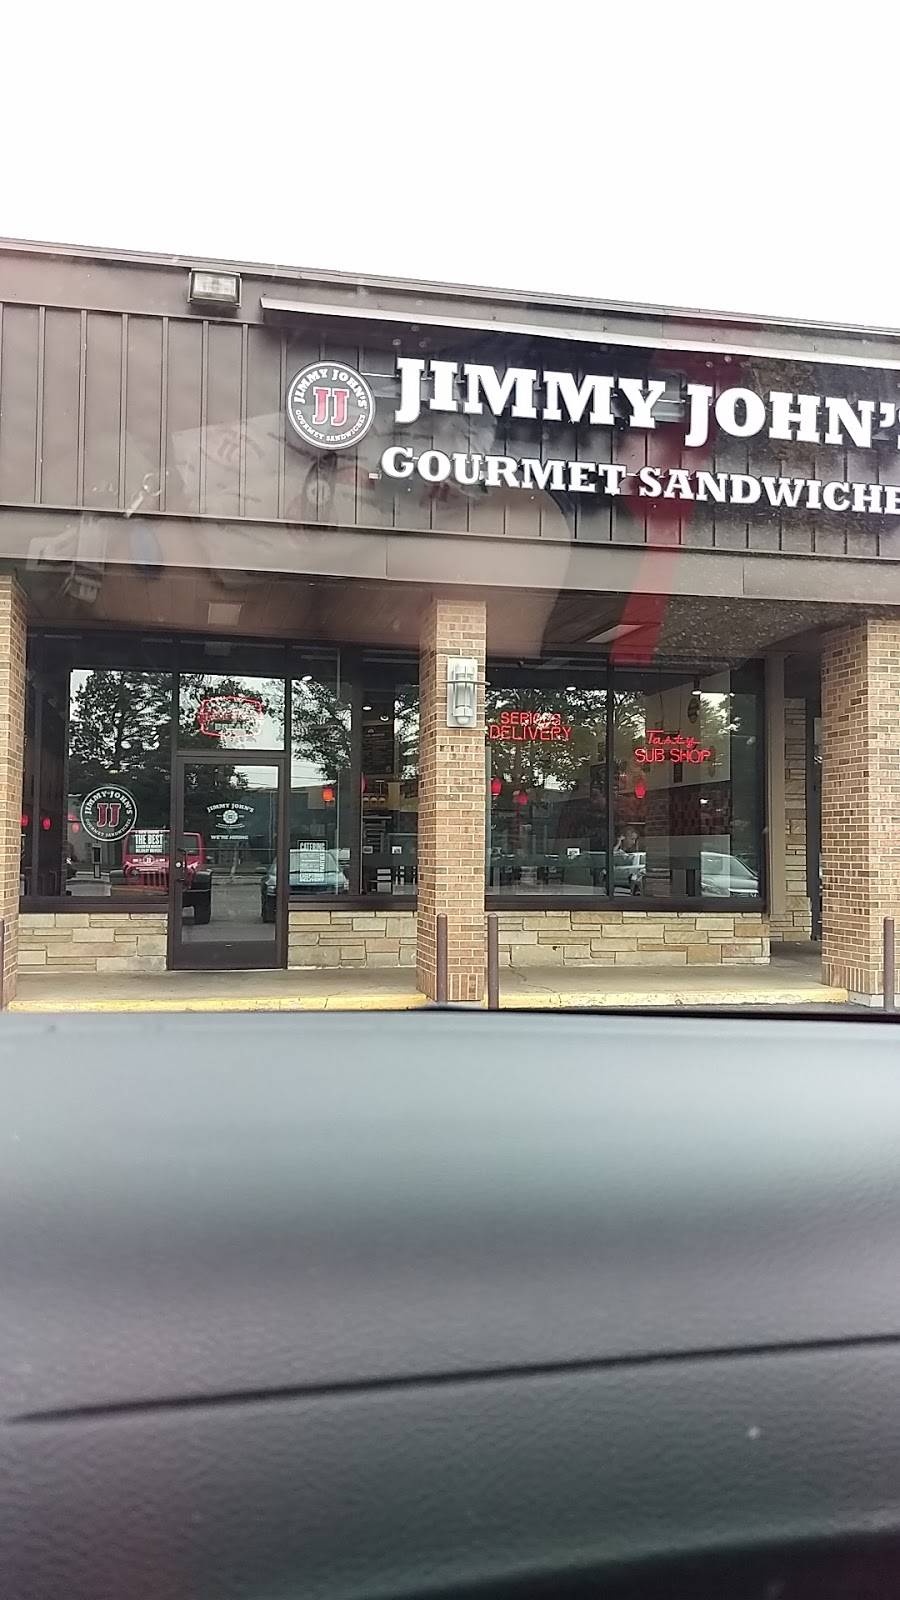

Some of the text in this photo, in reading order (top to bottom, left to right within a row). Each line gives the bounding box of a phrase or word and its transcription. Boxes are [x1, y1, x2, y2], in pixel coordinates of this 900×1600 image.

[294, 369, 367, 408] JIMMY JOHN'S
[395, 357, 665, 429] JIMMY
[381, 446, 626, 496] GOURMET
[489, 724, 572, 741] DELIVERY
[646, 730, 703, 748] Tasty
[634, 748, 711, 764] SUB SHOP
[84, 790, 107, 815] JIMMY
[135, 834, 164, 845] THE BEST
